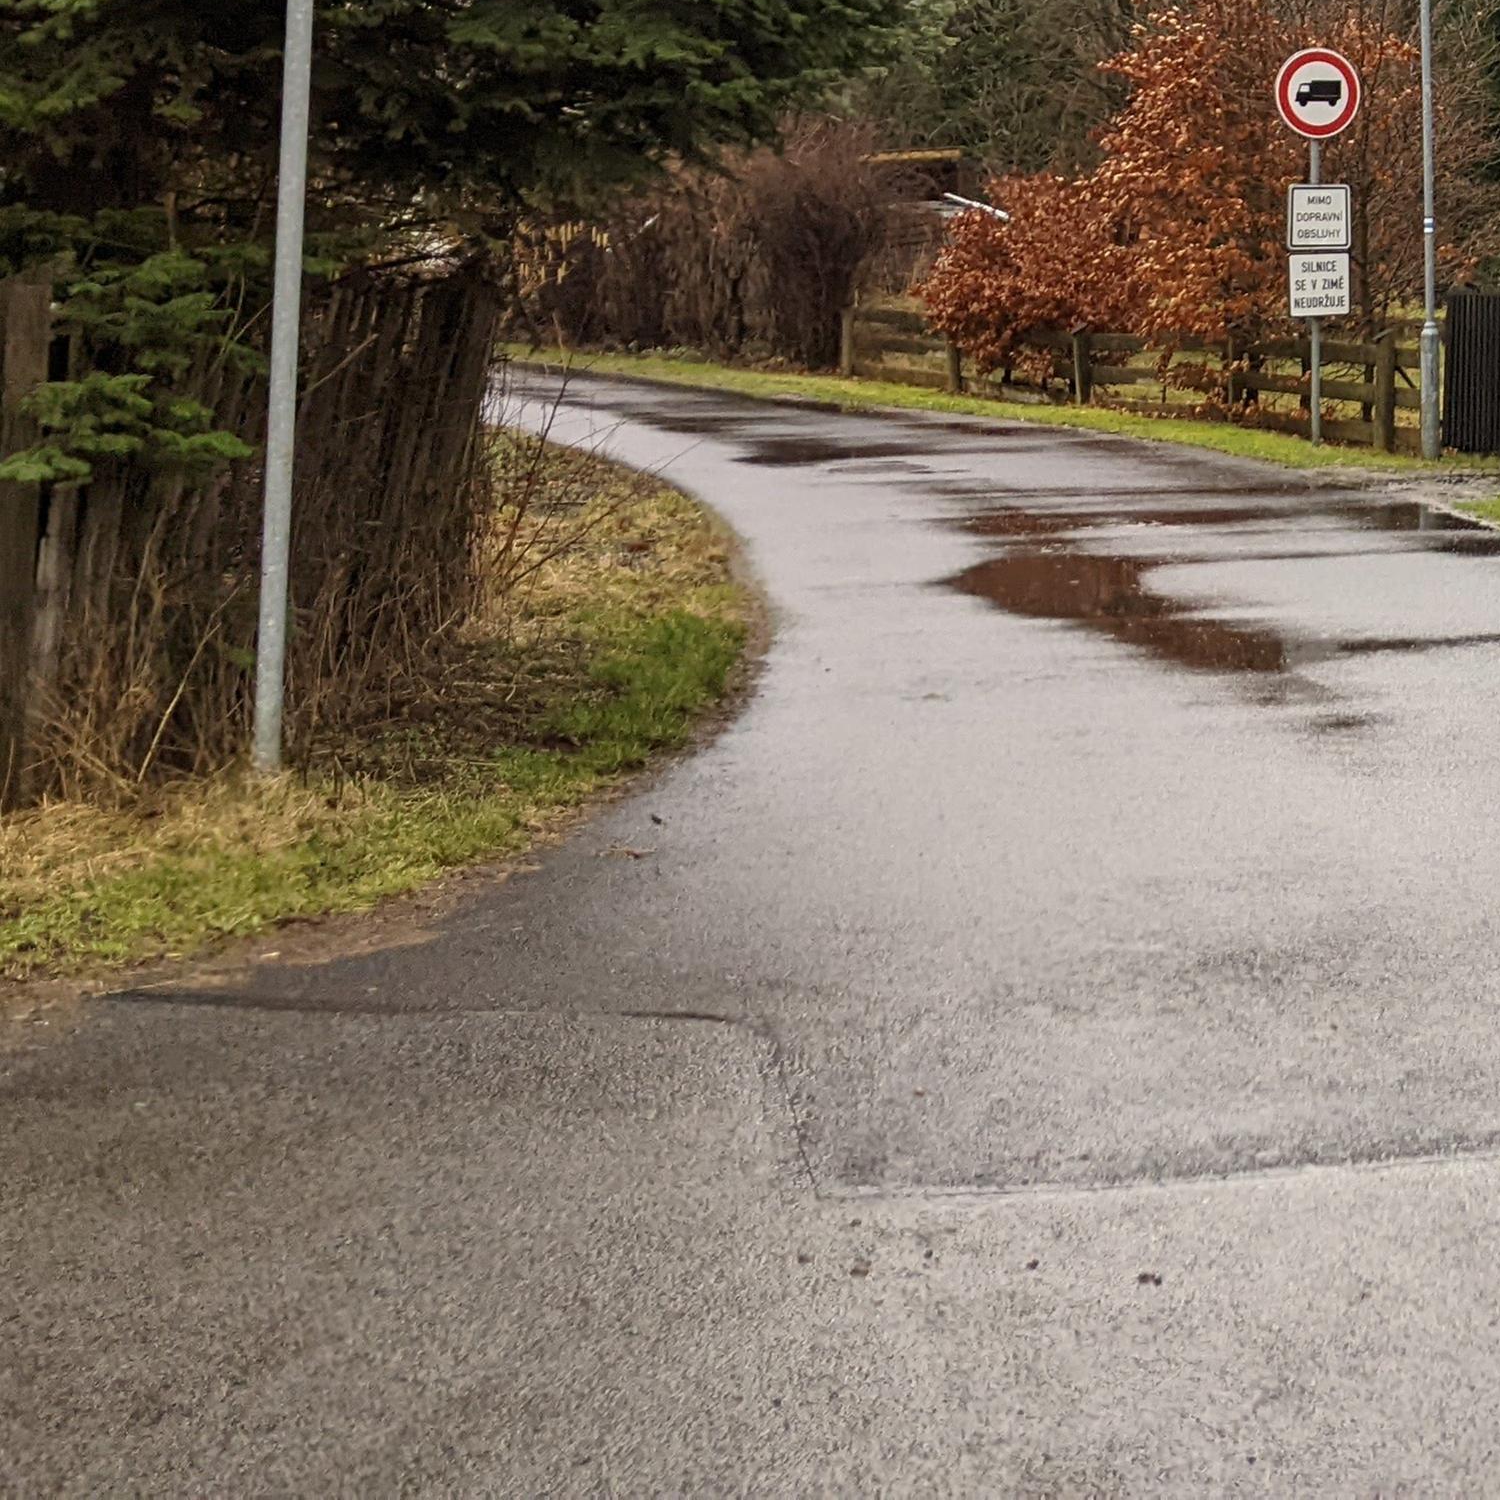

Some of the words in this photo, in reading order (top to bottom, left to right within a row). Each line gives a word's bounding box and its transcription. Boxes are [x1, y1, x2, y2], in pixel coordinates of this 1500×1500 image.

[1307, 195, 1332, 205] MIMO
[1296, 210, 1343, 222] DOPRAVNÍ
[1297, 228, 1341, 239] OBSLUHY
[1301, 260, 1337, 273] SILNICE
[1294, 279, 1306, 291] SE
[1311, 279, 1317, 290] V
[1294, 295, 1346, 309] NEUDRŽUJE
